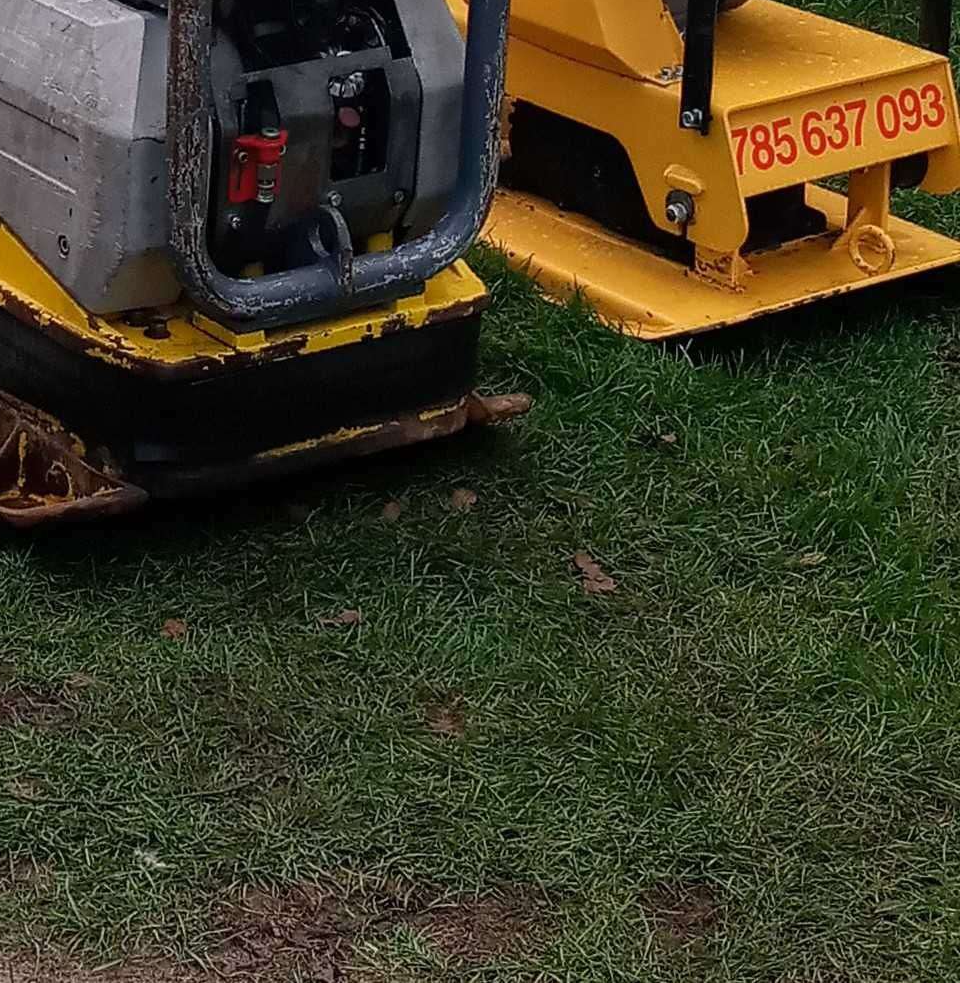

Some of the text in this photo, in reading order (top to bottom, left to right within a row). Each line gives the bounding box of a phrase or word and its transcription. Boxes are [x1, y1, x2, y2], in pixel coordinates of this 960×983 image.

[731, 83, 945, 175] 785 637 093
